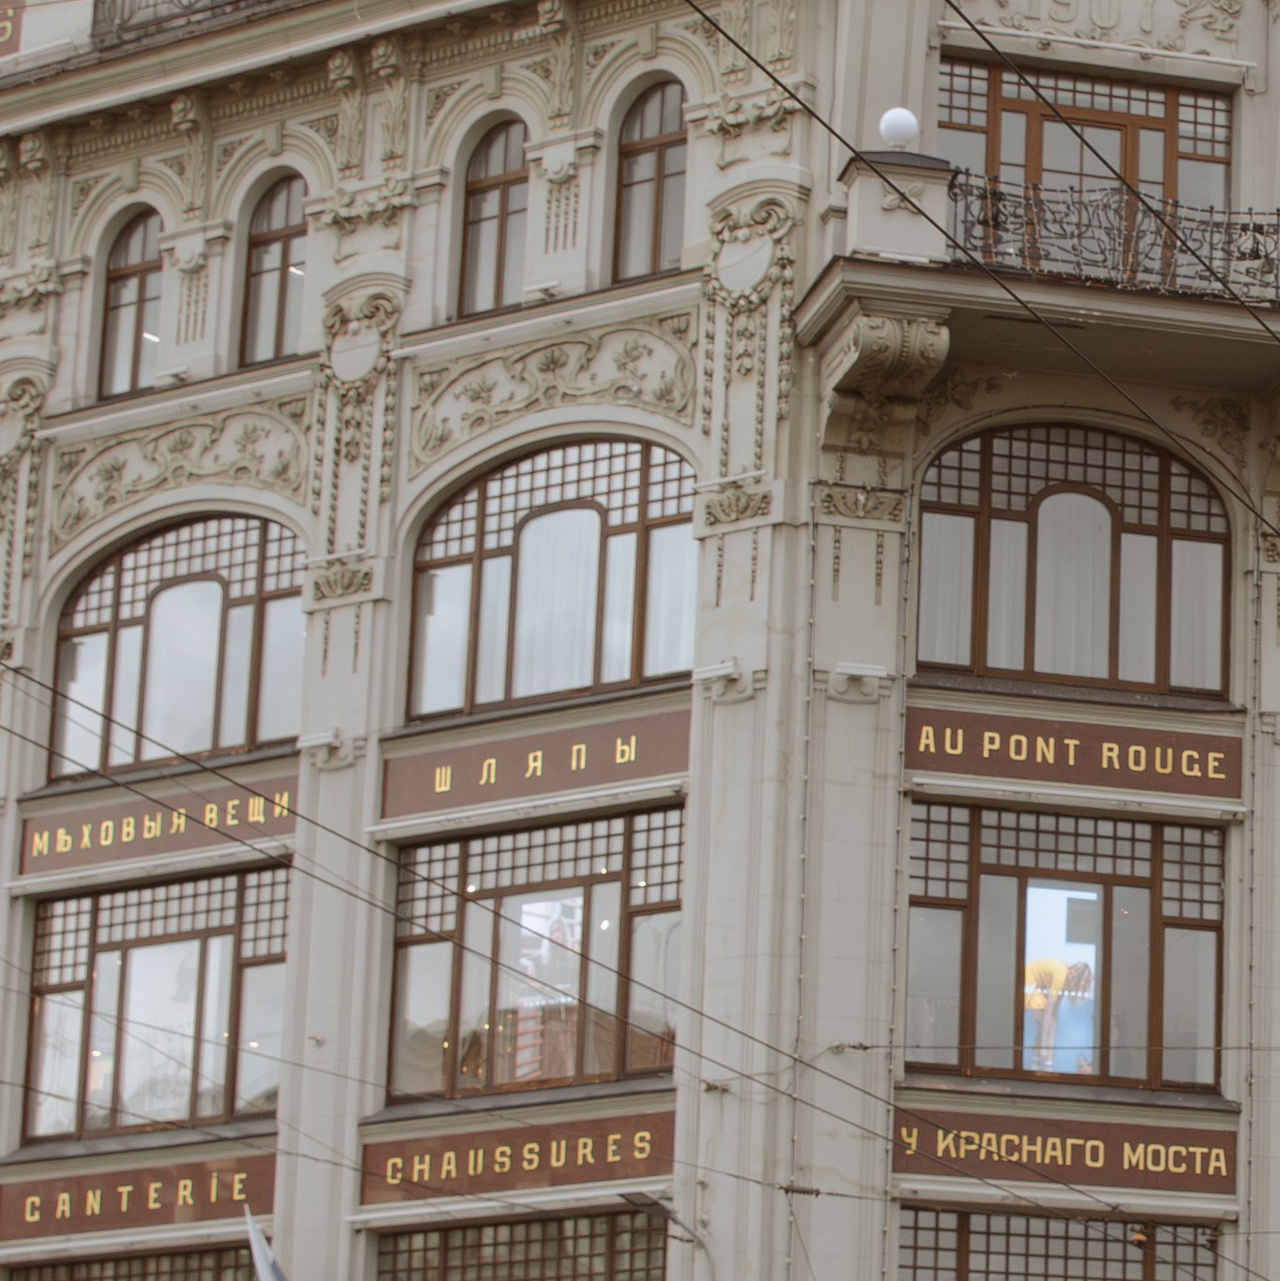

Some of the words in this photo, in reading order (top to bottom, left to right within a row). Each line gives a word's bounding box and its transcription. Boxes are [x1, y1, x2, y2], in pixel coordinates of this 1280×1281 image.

[434, 735, 638, 794] ШЛЯПЫ
[918, 725, 964, 756] AU
[982, 732, 1081, 766] PONT
[1102, 741, 1228, 780] ROUGE
[204, 791, 290, 829] ВЕЩИ
[386, 1130, 651, 1185] CHAUSSURES
[936, 1128, 1105, 1169] КРАСНАГО
[1123, 1141, 1229, 1177] МОСТА
